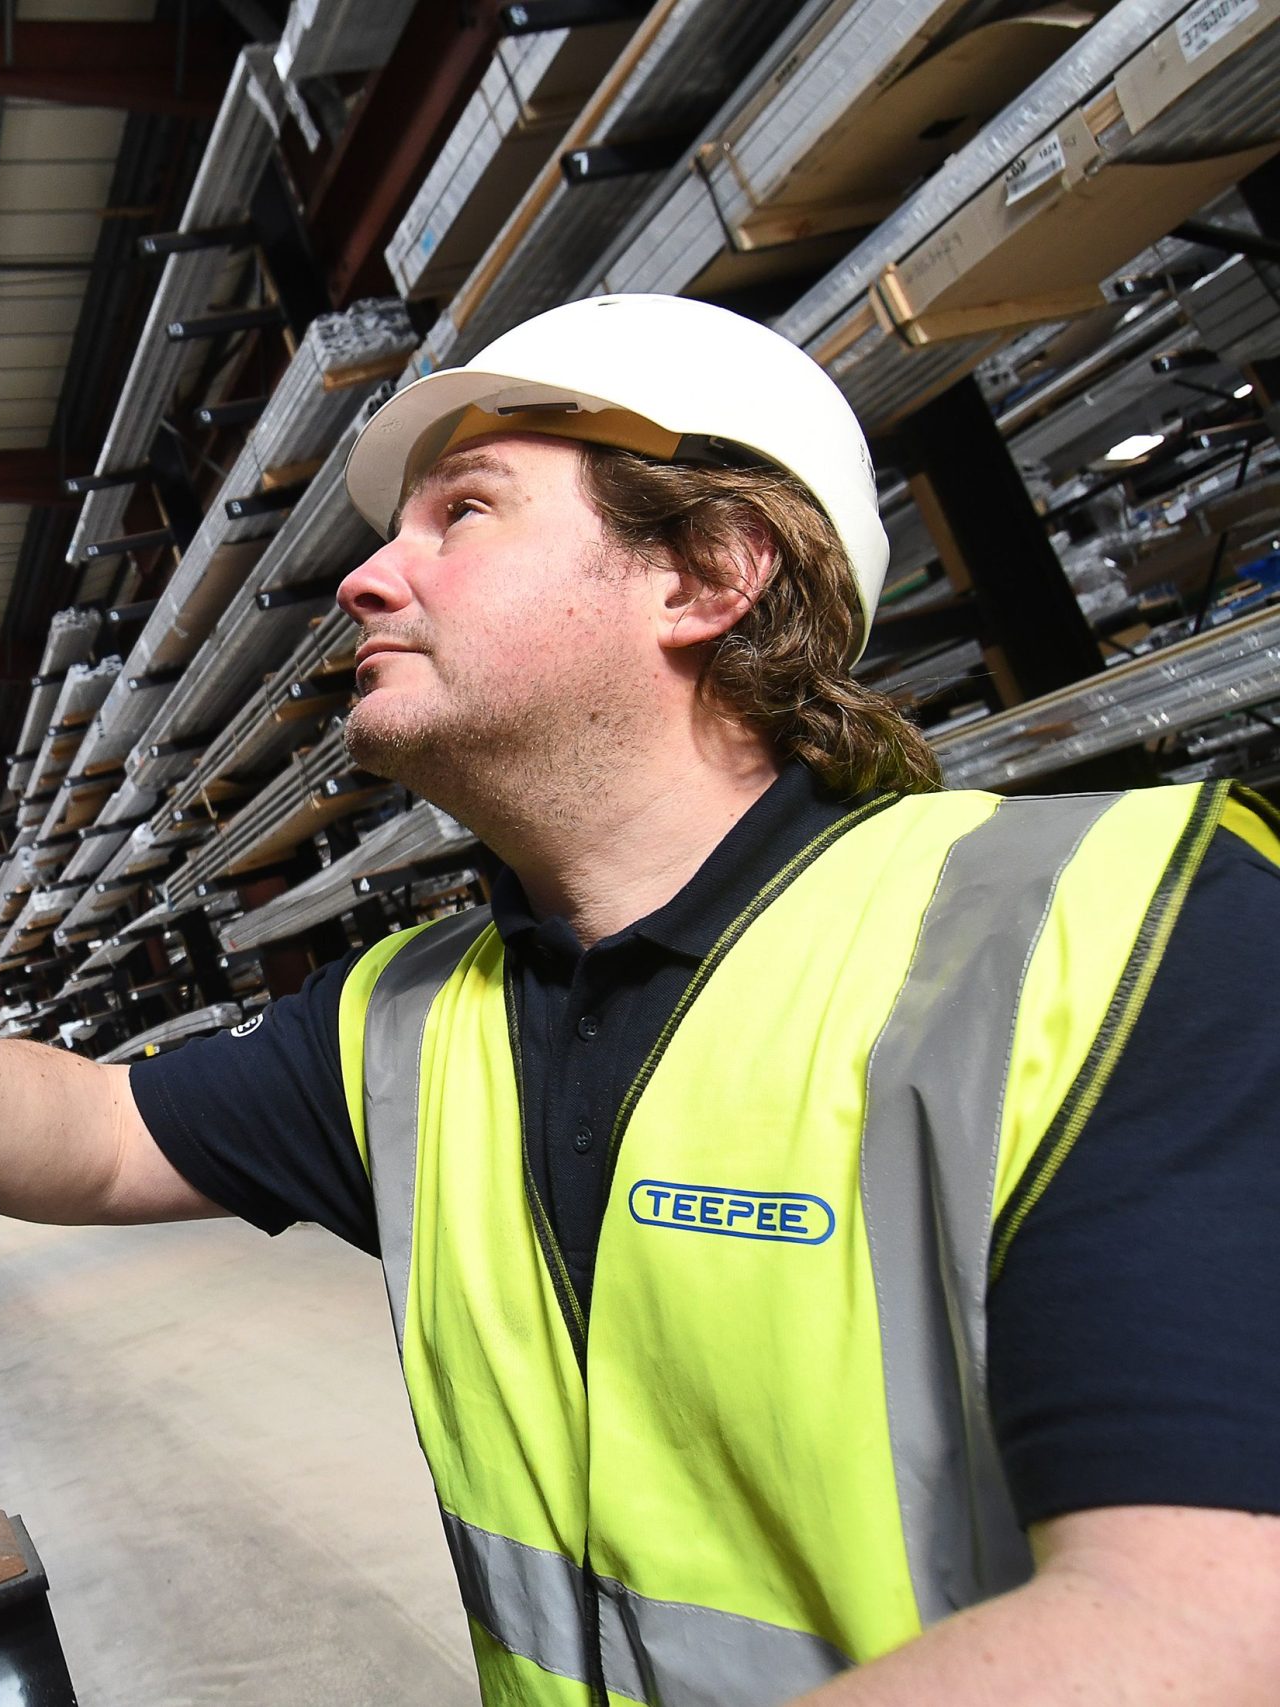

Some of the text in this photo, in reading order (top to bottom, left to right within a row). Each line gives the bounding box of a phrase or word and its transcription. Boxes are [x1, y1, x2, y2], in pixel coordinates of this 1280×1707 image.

[572, 151, 589, 175] 7
[261, 593, 270, 607] 7
[290, 682, 301, 697] 6
[325, 779, 338, 795] 5
[360, 877, 370, 892] 4
[646, 1189, 809, 1234] TEEPEE
